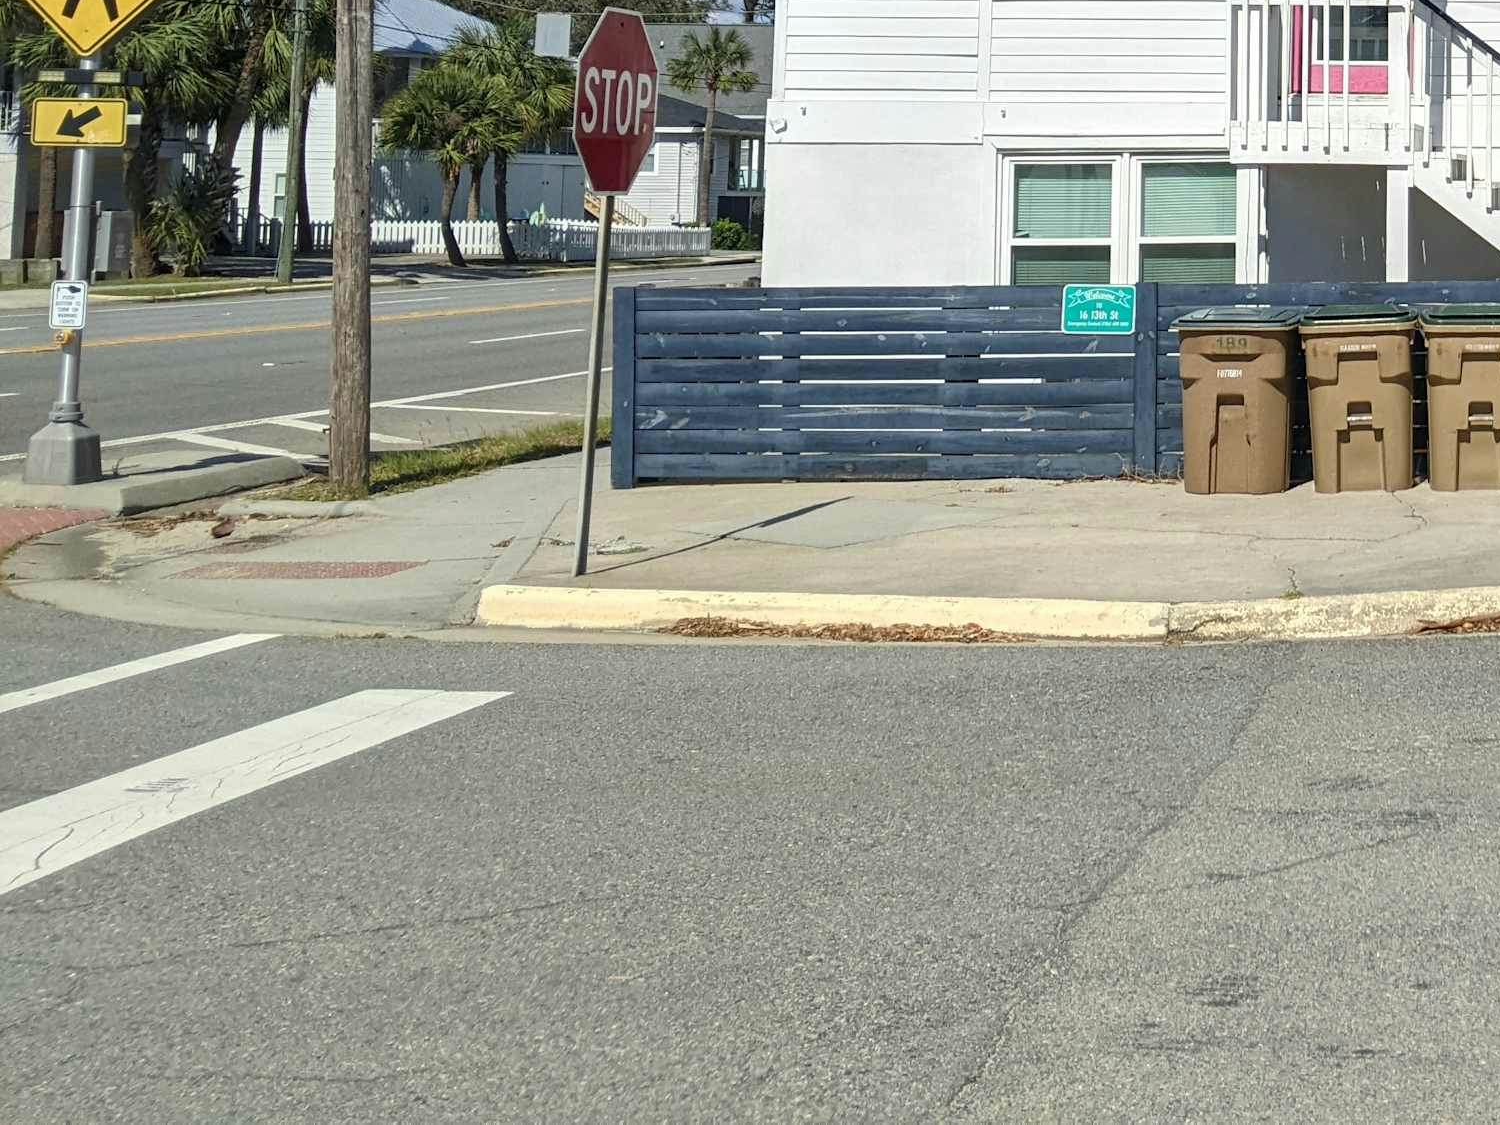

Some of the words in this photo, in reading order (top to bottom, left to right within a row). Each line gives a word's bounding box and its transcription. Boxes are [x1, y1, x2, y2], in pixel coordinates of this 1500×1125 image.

[581, 67, 652, 136] STOP
[1080, 310, 1088, 320] 16
[1091, 310, 1108, 320] 13th
[1110, 310, 1119, 320] St
[1216, 337, 1248, 348] 189
